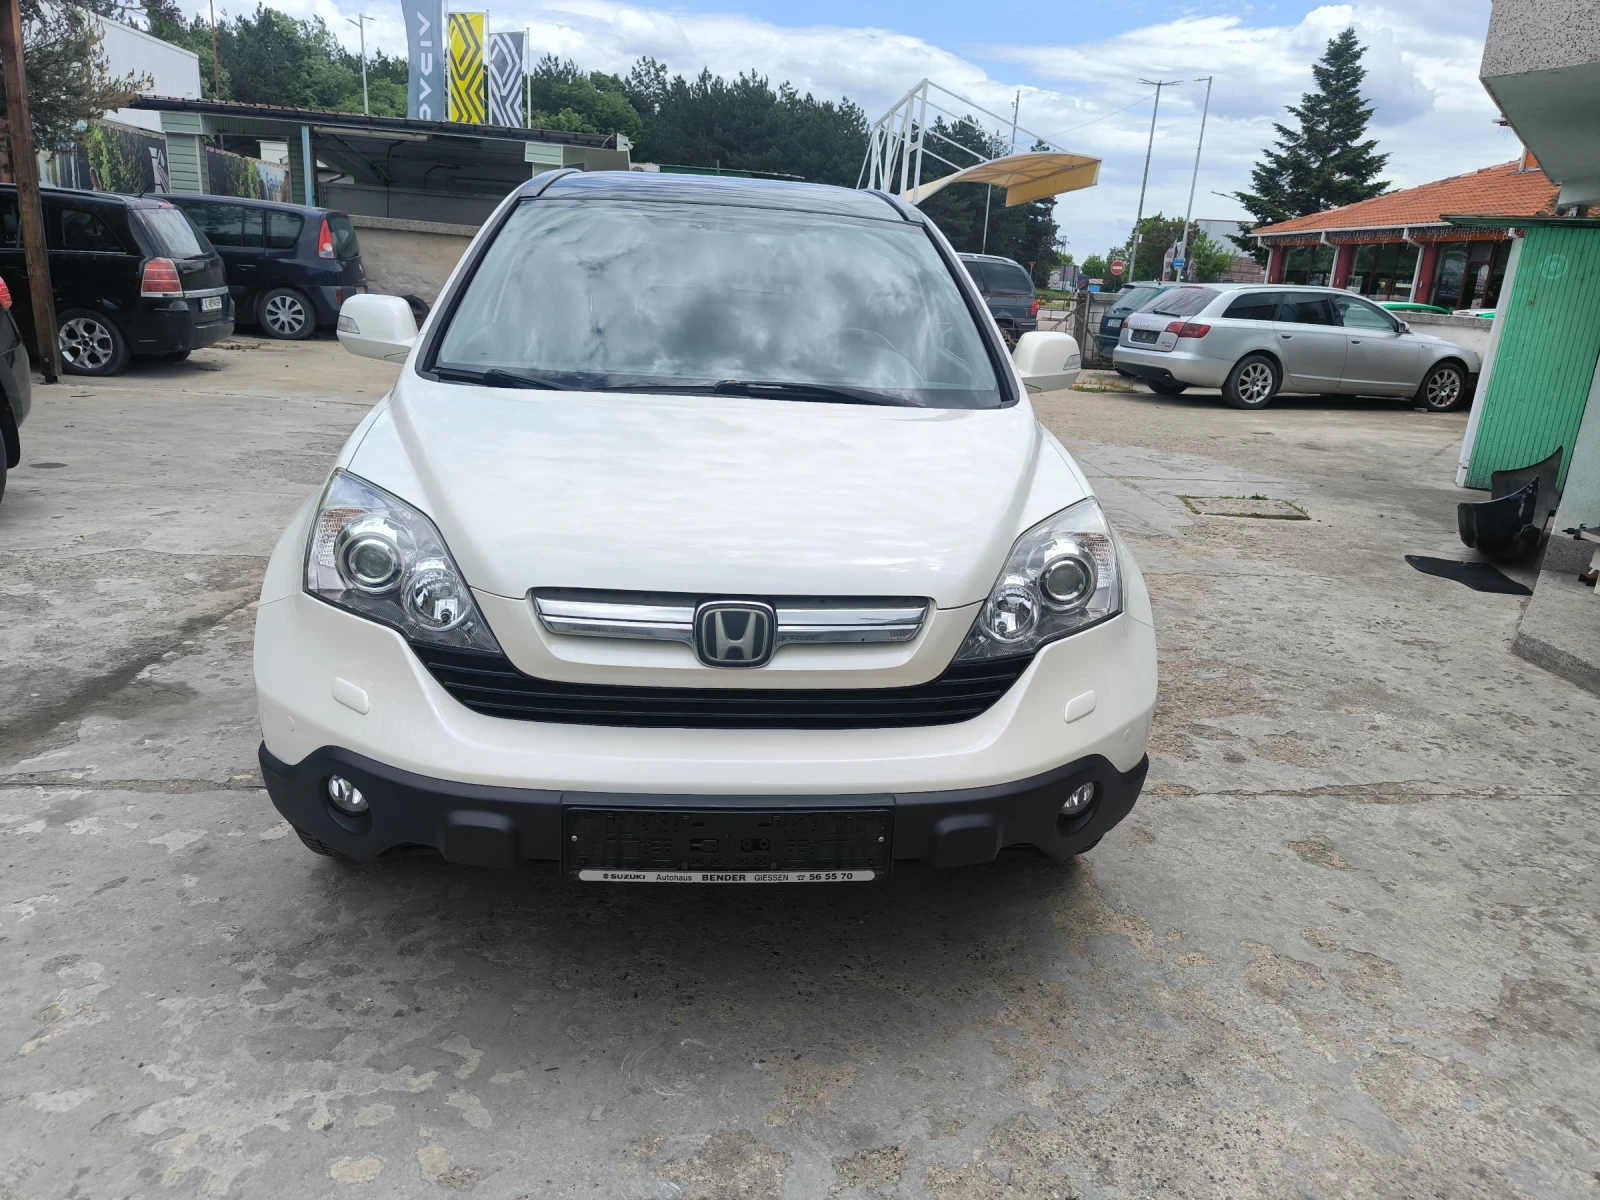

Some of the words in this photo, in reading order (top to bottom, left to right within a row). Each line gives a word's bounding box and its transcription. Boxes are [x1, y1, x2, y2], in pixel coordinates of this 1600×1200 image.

[656, 873, 693, 882] Autohaus
[701, 874, 746, 882] BENDER
[754, 874, 789, 882] GIESSEN
[809, 873, 822, 881] 56
[841, 872, 853, 880] 70
